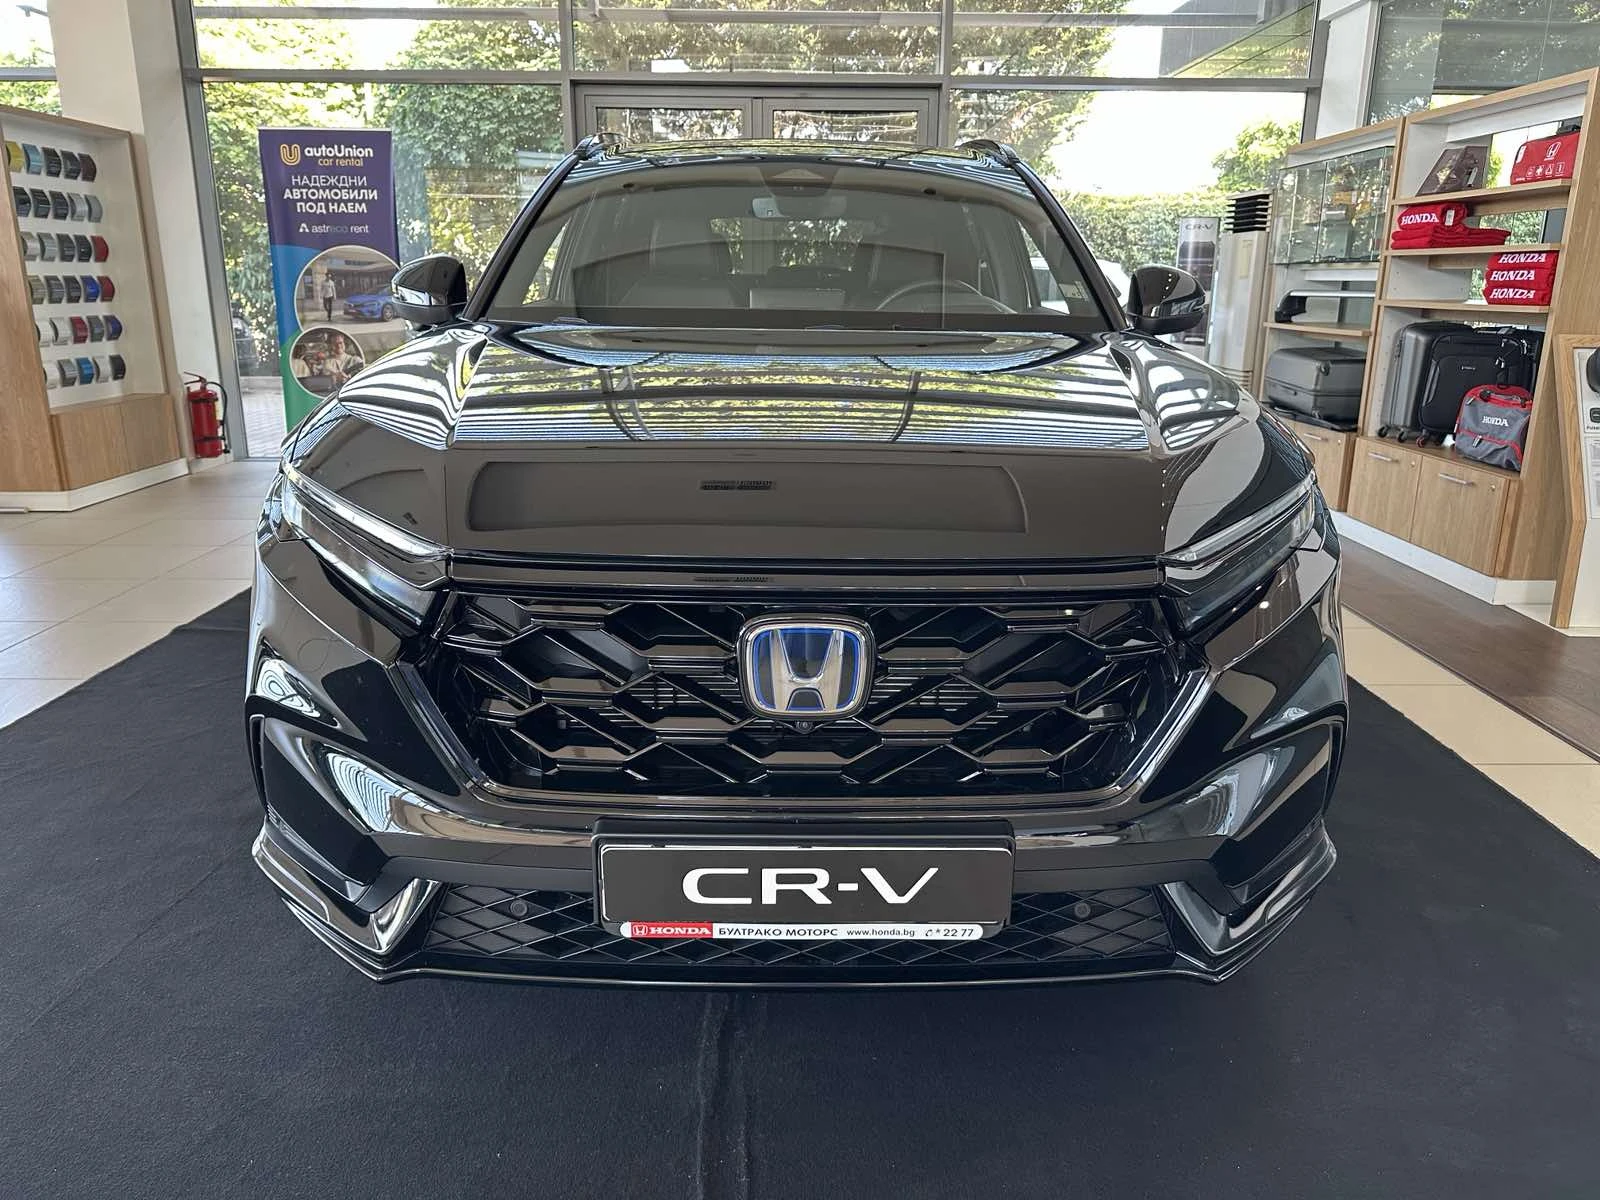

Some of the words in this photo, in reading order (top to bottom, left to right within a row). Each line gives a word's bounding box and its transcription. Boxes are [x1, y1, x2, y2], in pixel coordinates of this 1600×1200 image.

[304, 144, 374, 157] autoUnion
[318, 158, 333, 166] car
[336, 158, 364, 166] rental
[291, 175, 368, 188] НАДЕЖДНИ
[283, 189, 378, 200] АВТОМОБИЛИ
[297, 202, 326, 214] ПОД
[329, 202, 368, 213] НАЕМ
[1400, 213, 1440, 226] HONDA
[350, 224, 369, 233] rent
[1185, 223, 1214, 231] CR-V
[1498, 253, 1547, 264] HONDA
[1490, 270, 1536, 281] HONDA
[1490, 288, 1536, 299] HONDA
[1482, 415, 1509, 427] HONDA
[682, 867, 939, 905] CR-V
[650, 926, 712, 936] HONDA
[718, 927, 782, 938] БУЛТРАКО
[785, 928, 839, 938] МОТОРС
[846, 927, 916, 939] www.honda.bg
